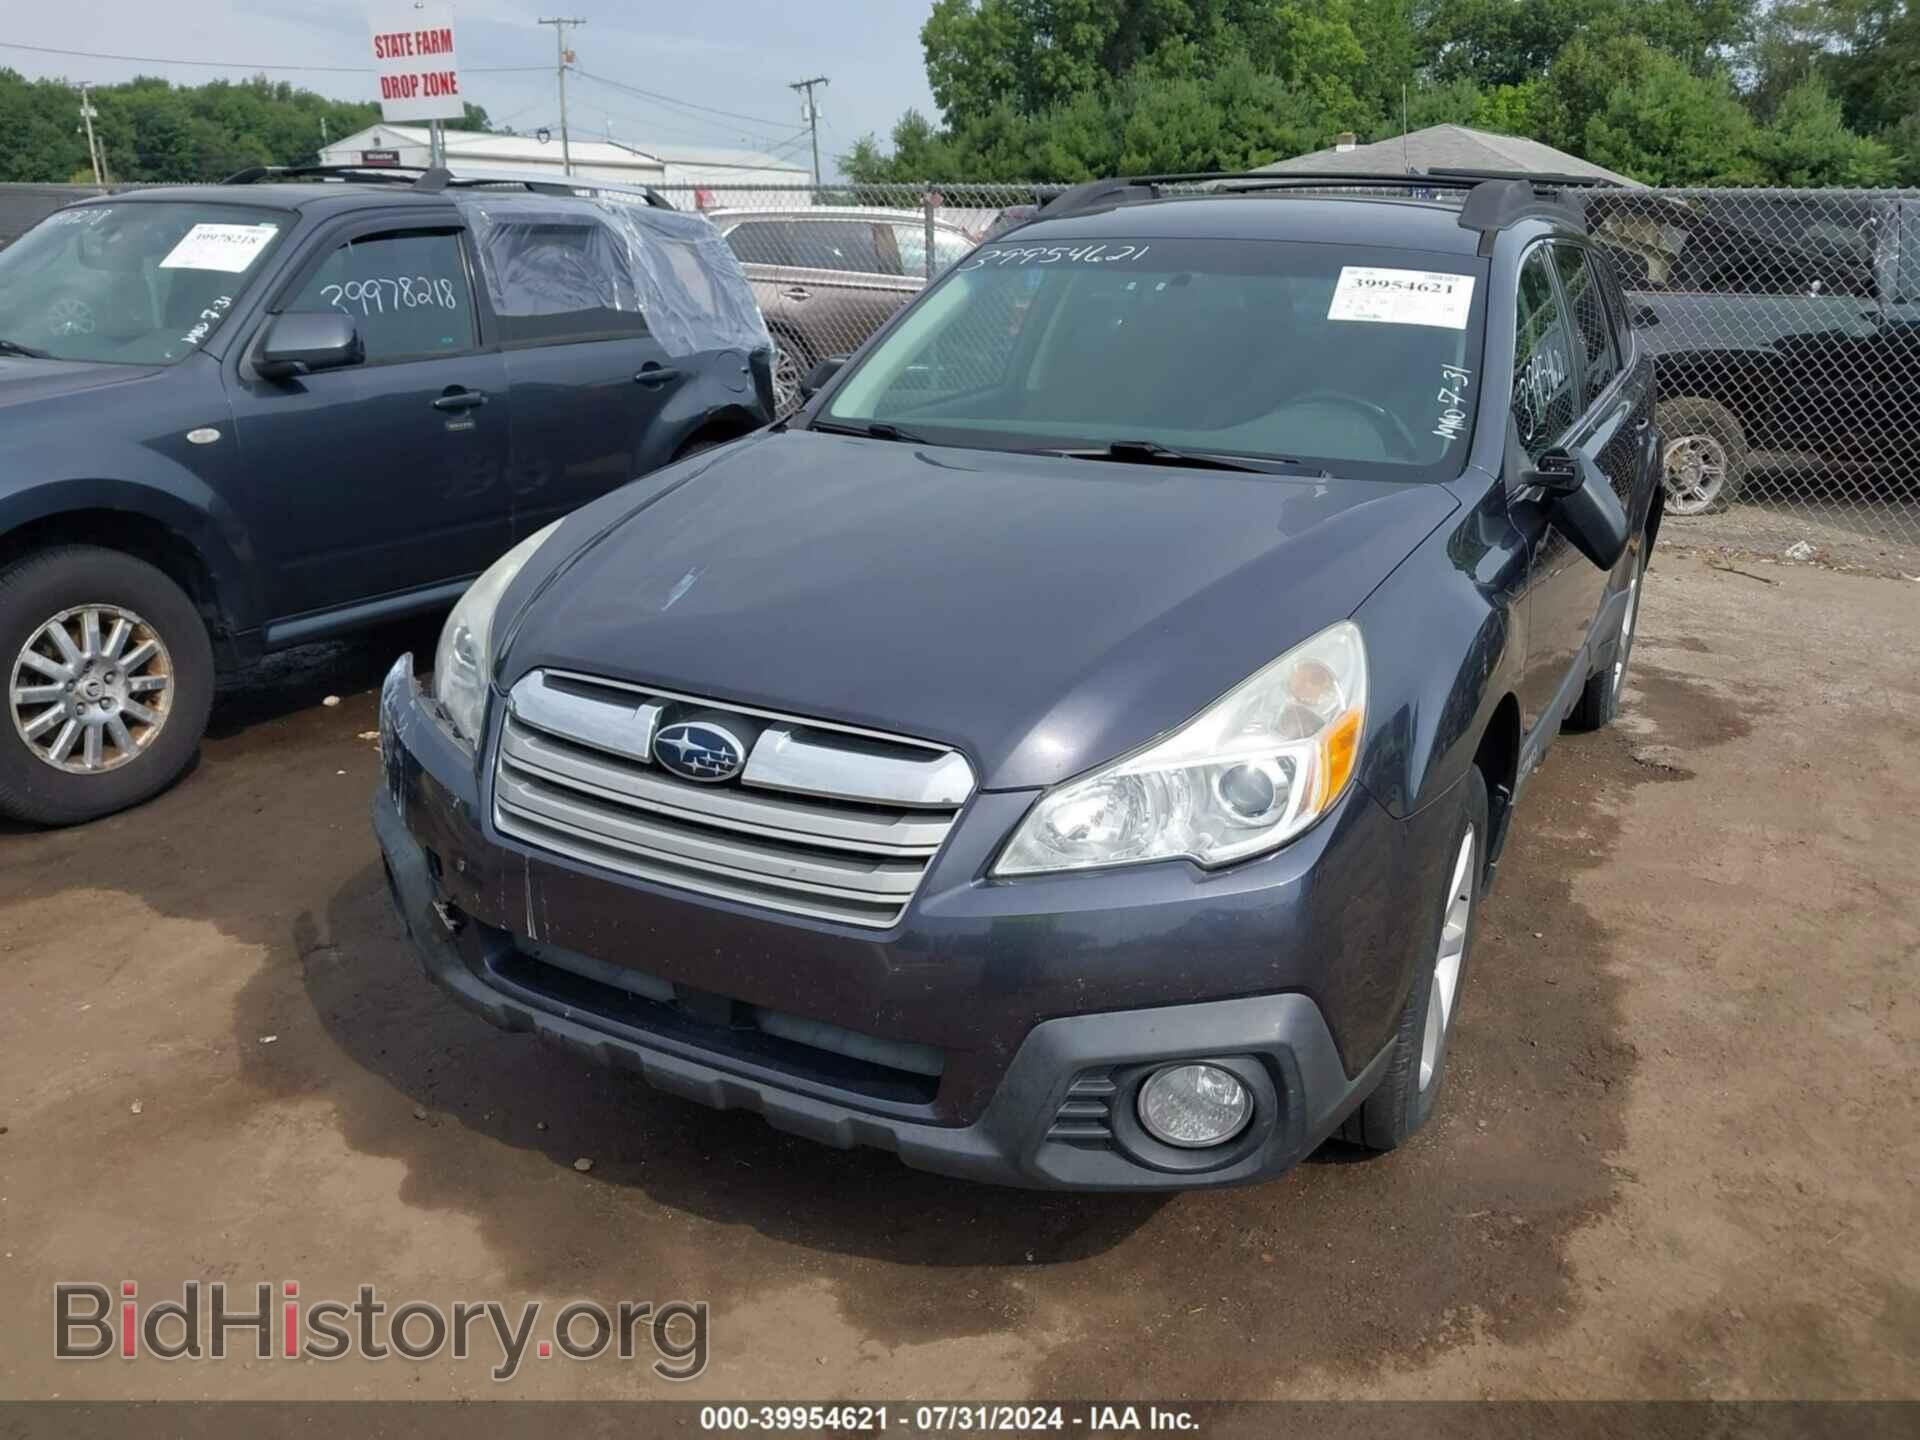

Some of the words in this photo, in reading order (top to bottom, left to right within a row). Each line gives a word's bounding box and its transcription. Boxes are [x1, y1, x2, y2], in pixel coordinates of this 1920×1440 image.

[374, 32, 413, 59] STATE
[415, 28, 454, 55] FARM
[380, 74, 418, 99] DROP
[422, 71, 458, 96] ZONE
[957, 244, 1150, 272] 39954621
[1350, 277, 1453, 294] 39954621
